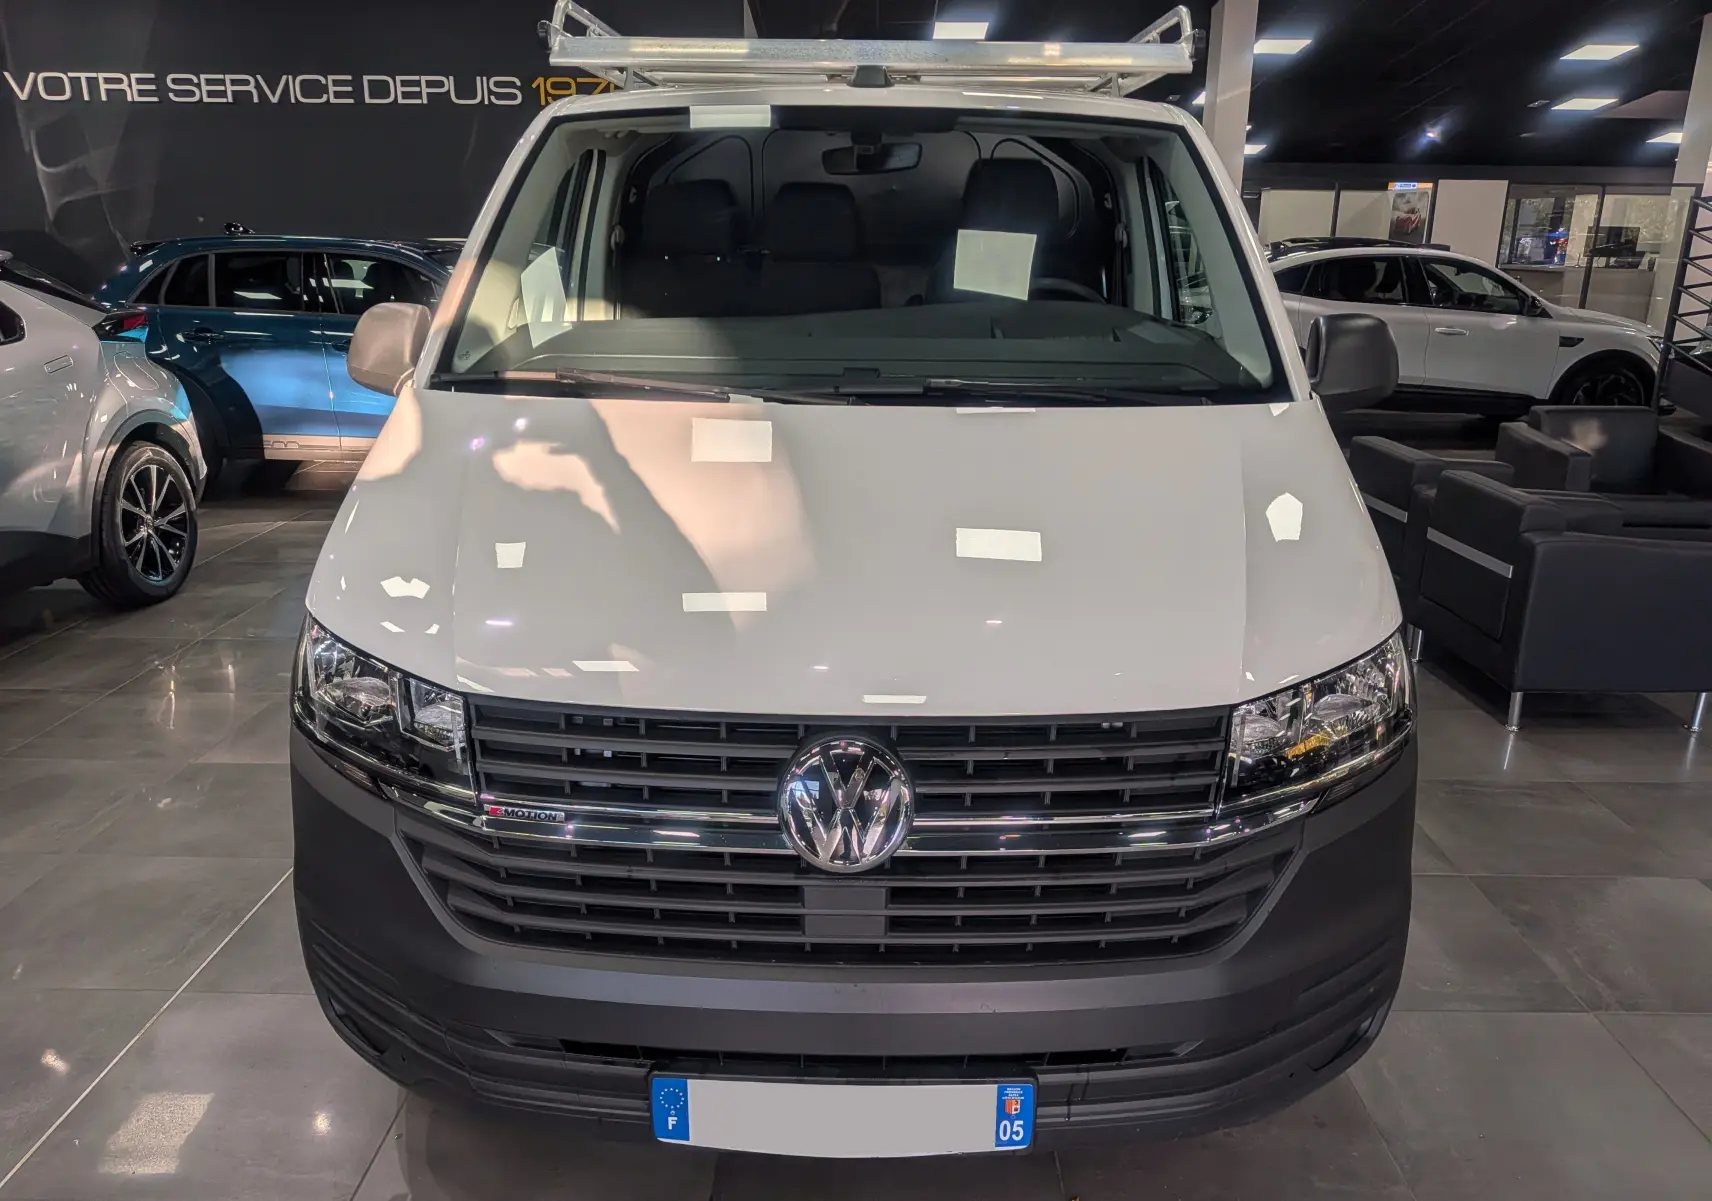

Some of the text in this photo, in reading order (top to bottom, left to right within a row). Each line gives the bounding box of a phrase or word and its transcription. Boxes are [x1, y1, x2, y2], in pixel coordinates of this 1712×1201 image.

[3, 72, 158, 102] VOTRE
[166, 74, 353, 104] SERVICE
[363, 75, 523, 105] DEPUIS
[667, 1116, 678, 1130] F
[999, 1120, 1024, 1141] 05
